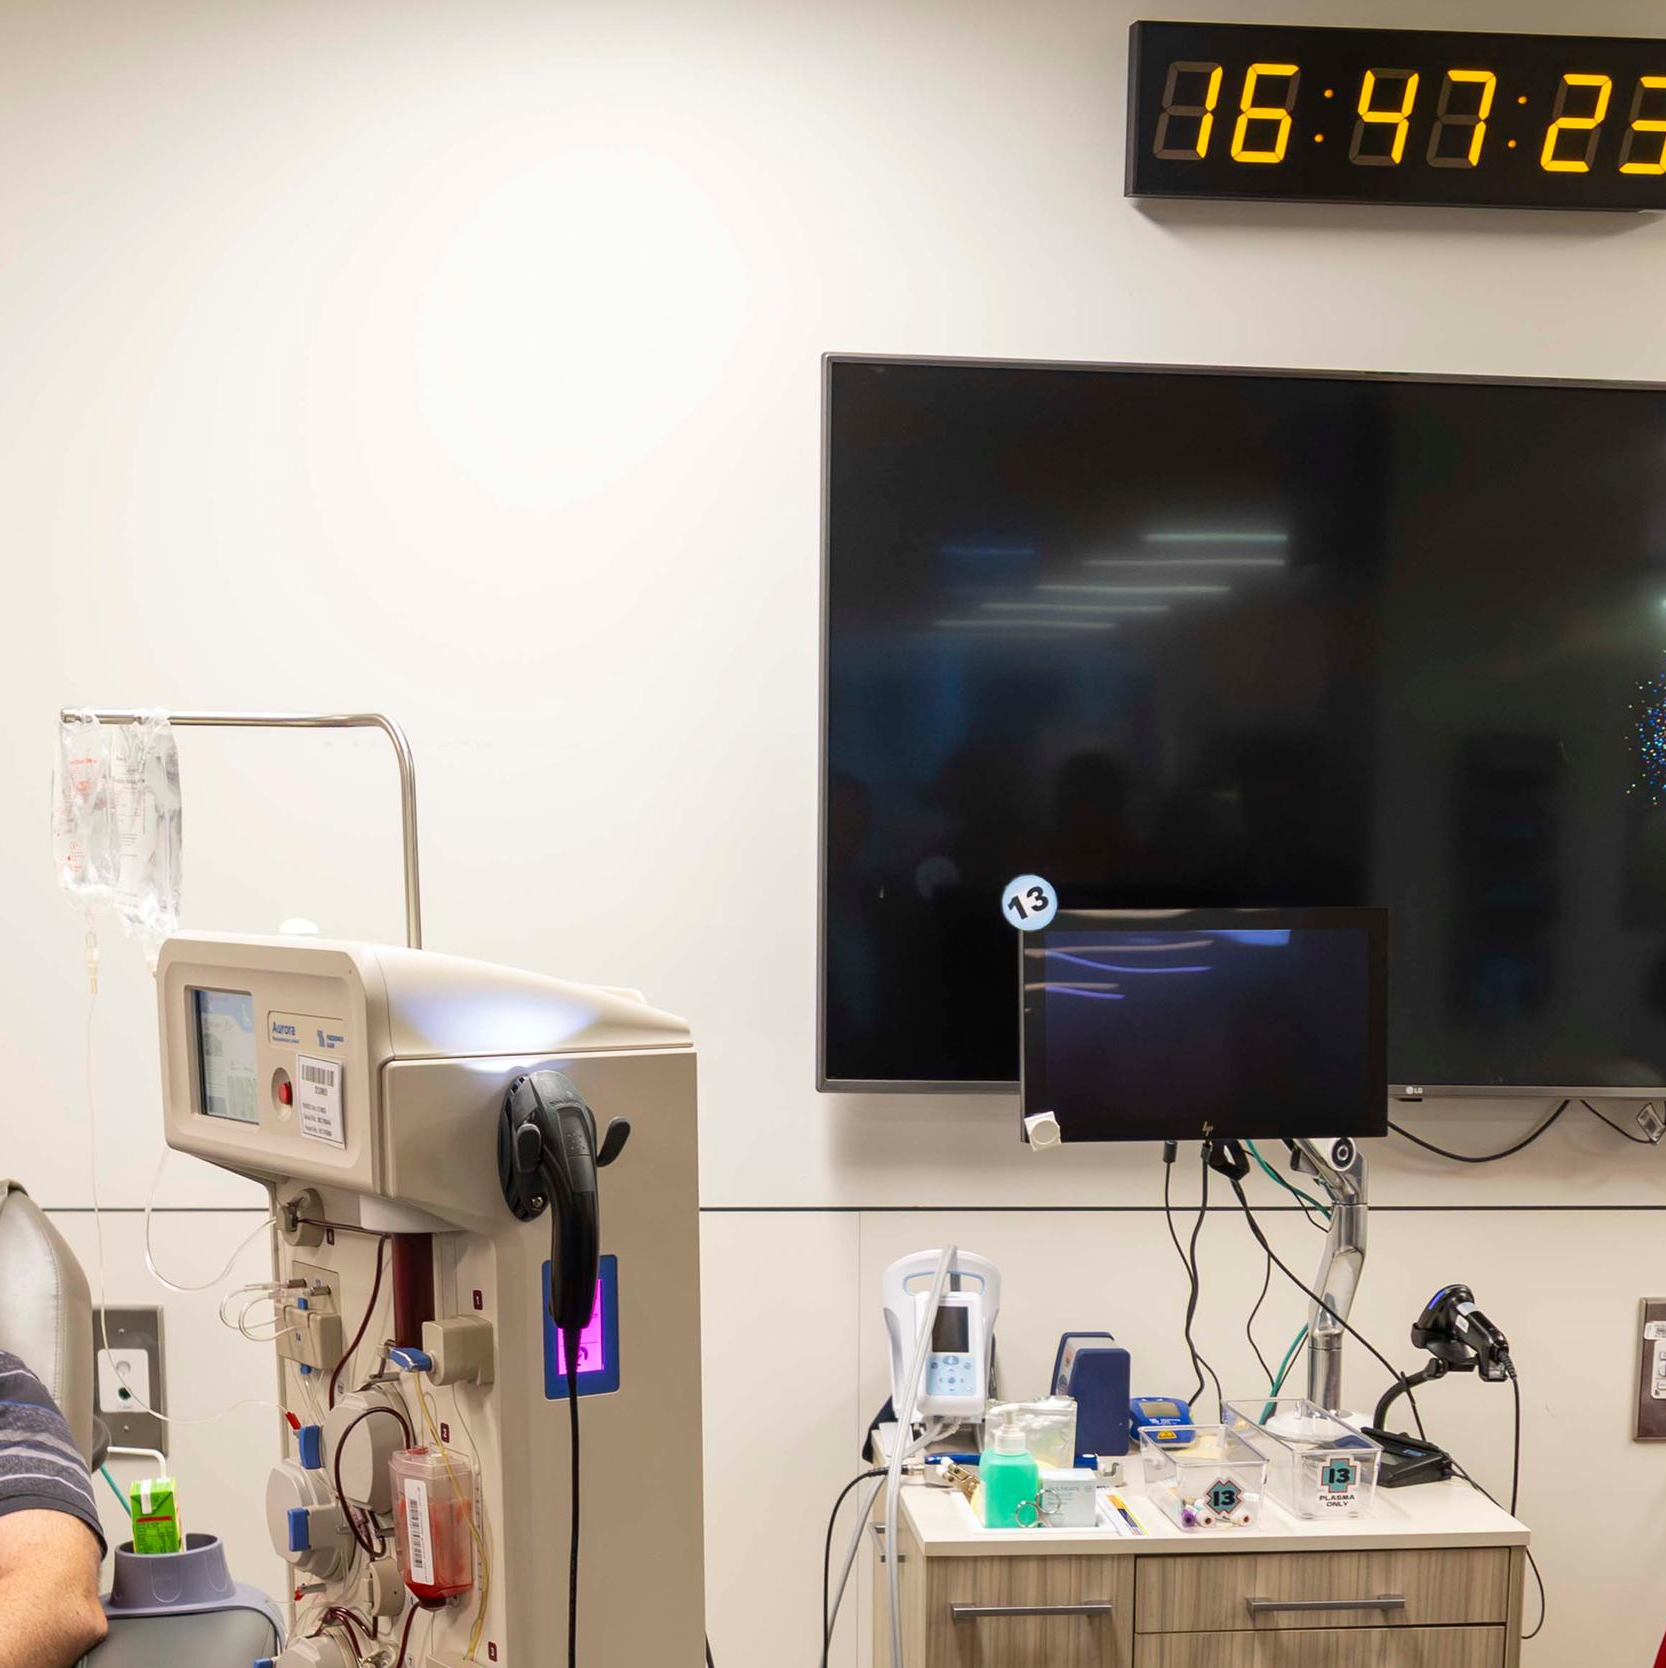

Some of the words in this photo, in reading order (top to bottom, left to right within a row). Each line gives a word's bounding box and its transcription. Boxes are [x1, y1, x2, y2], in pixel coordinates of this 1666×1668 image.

[1008, 886, 1049, 920] 13
[272, 1021, 296, 1036] Aurora
[1328, 1468, 1350, 1484] 13
[1213, 1490, 1235, 1507] 13
